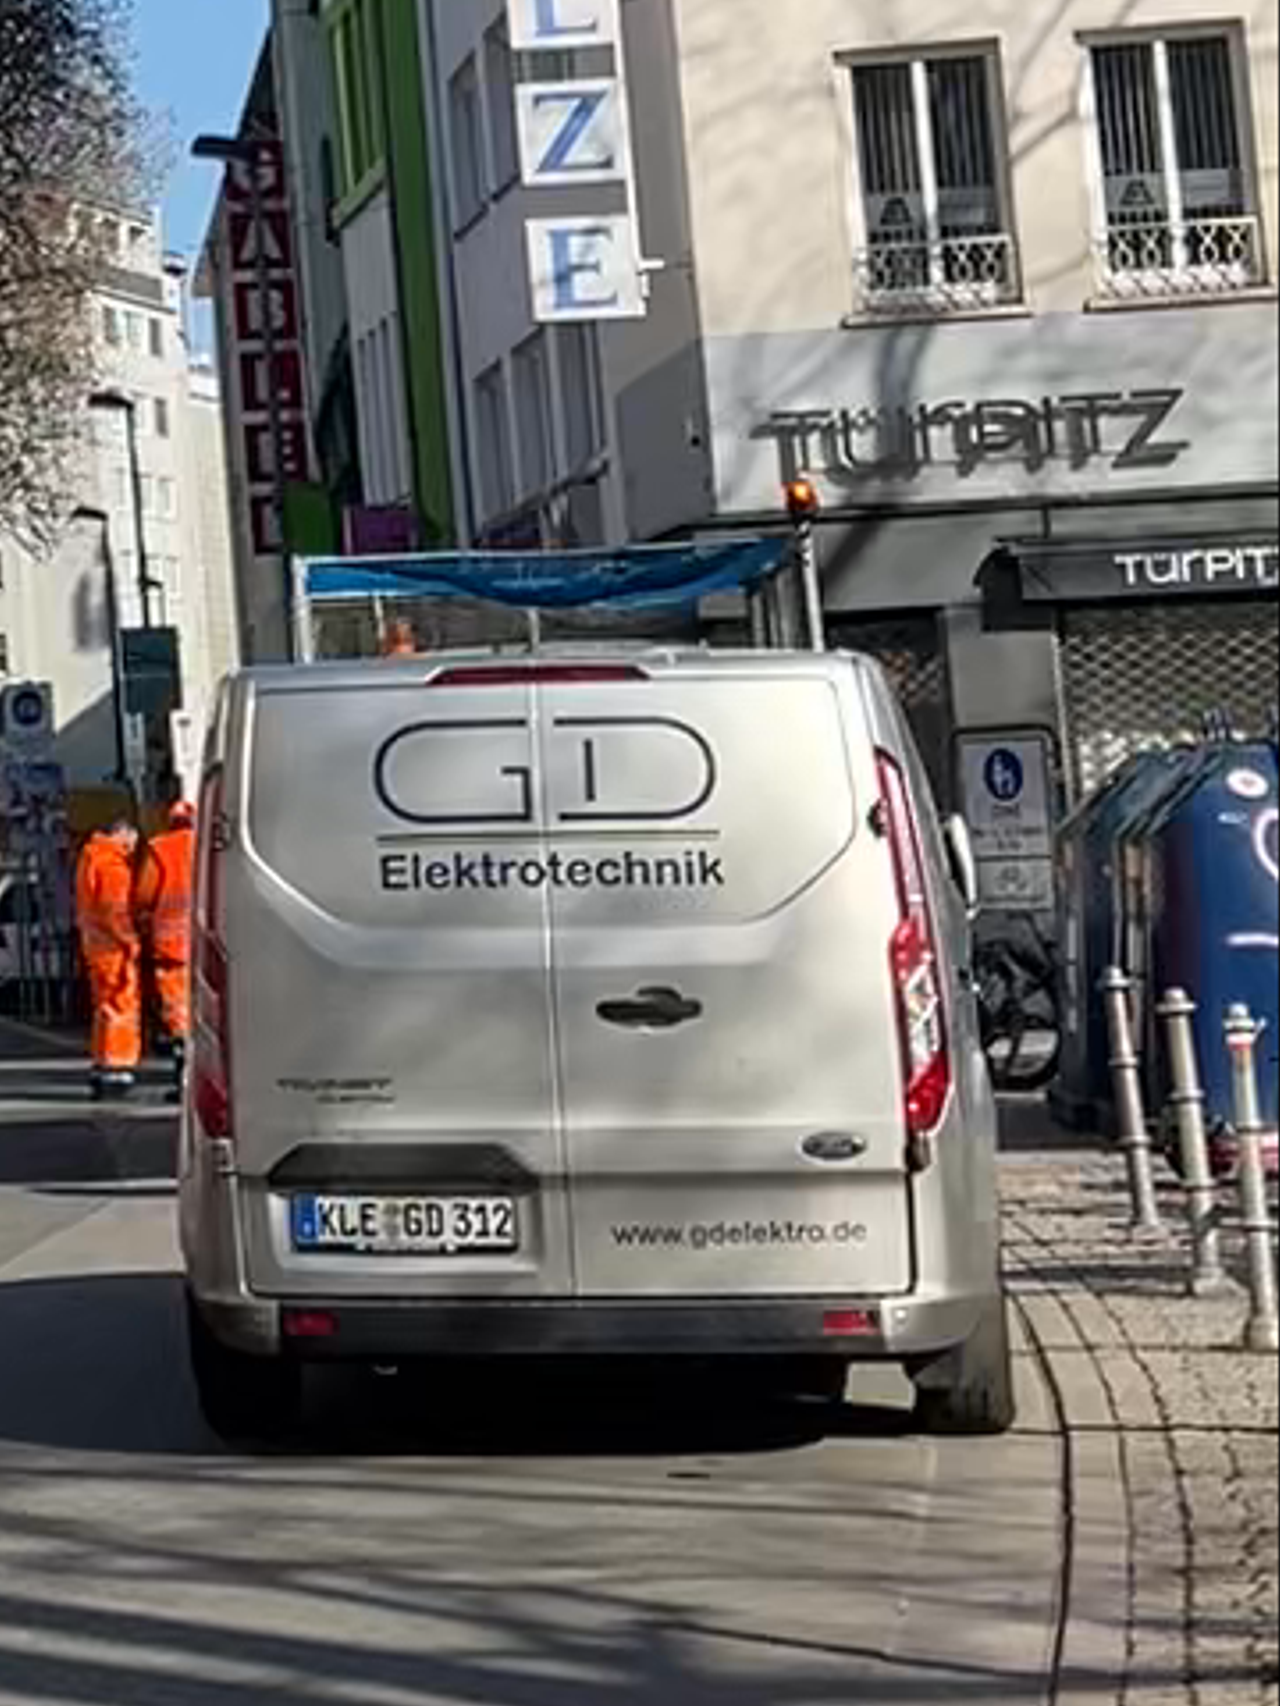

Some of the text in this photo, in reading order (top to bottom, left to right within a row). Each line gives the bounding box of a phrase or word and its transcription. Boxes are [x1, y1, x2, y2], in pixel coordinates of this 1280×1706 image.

[379, 851, 726, 890] Elektrotechnik
[318, 1202, 513, 1237] KLE GD 312
[610, 1221, 868, 1249] www.gdelektro.de
